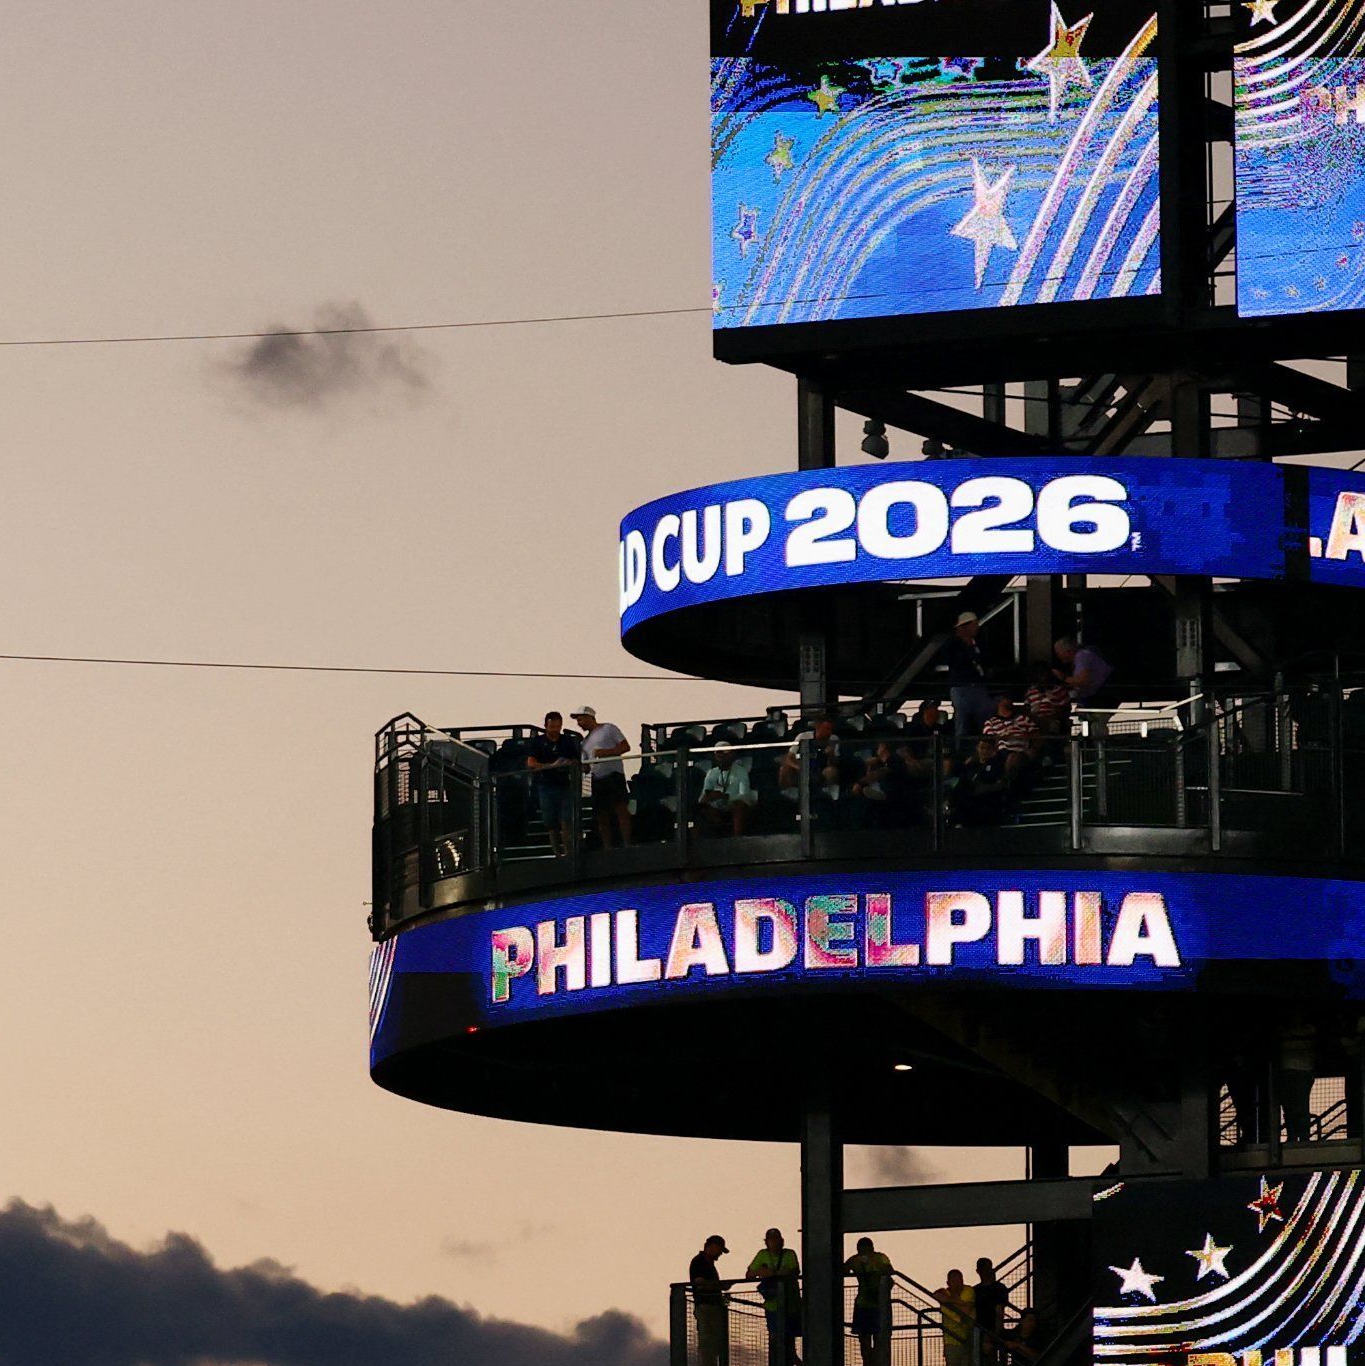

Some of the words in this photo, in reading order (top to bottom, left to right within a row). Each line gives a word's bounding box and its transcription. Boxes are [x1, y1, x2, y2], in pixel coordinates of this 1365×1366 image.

[652, 498, 772, 593] CUP
[785, 475, 1130, 568] 2026
[492, 890, 1182, 1004] PHILADELPHIA
